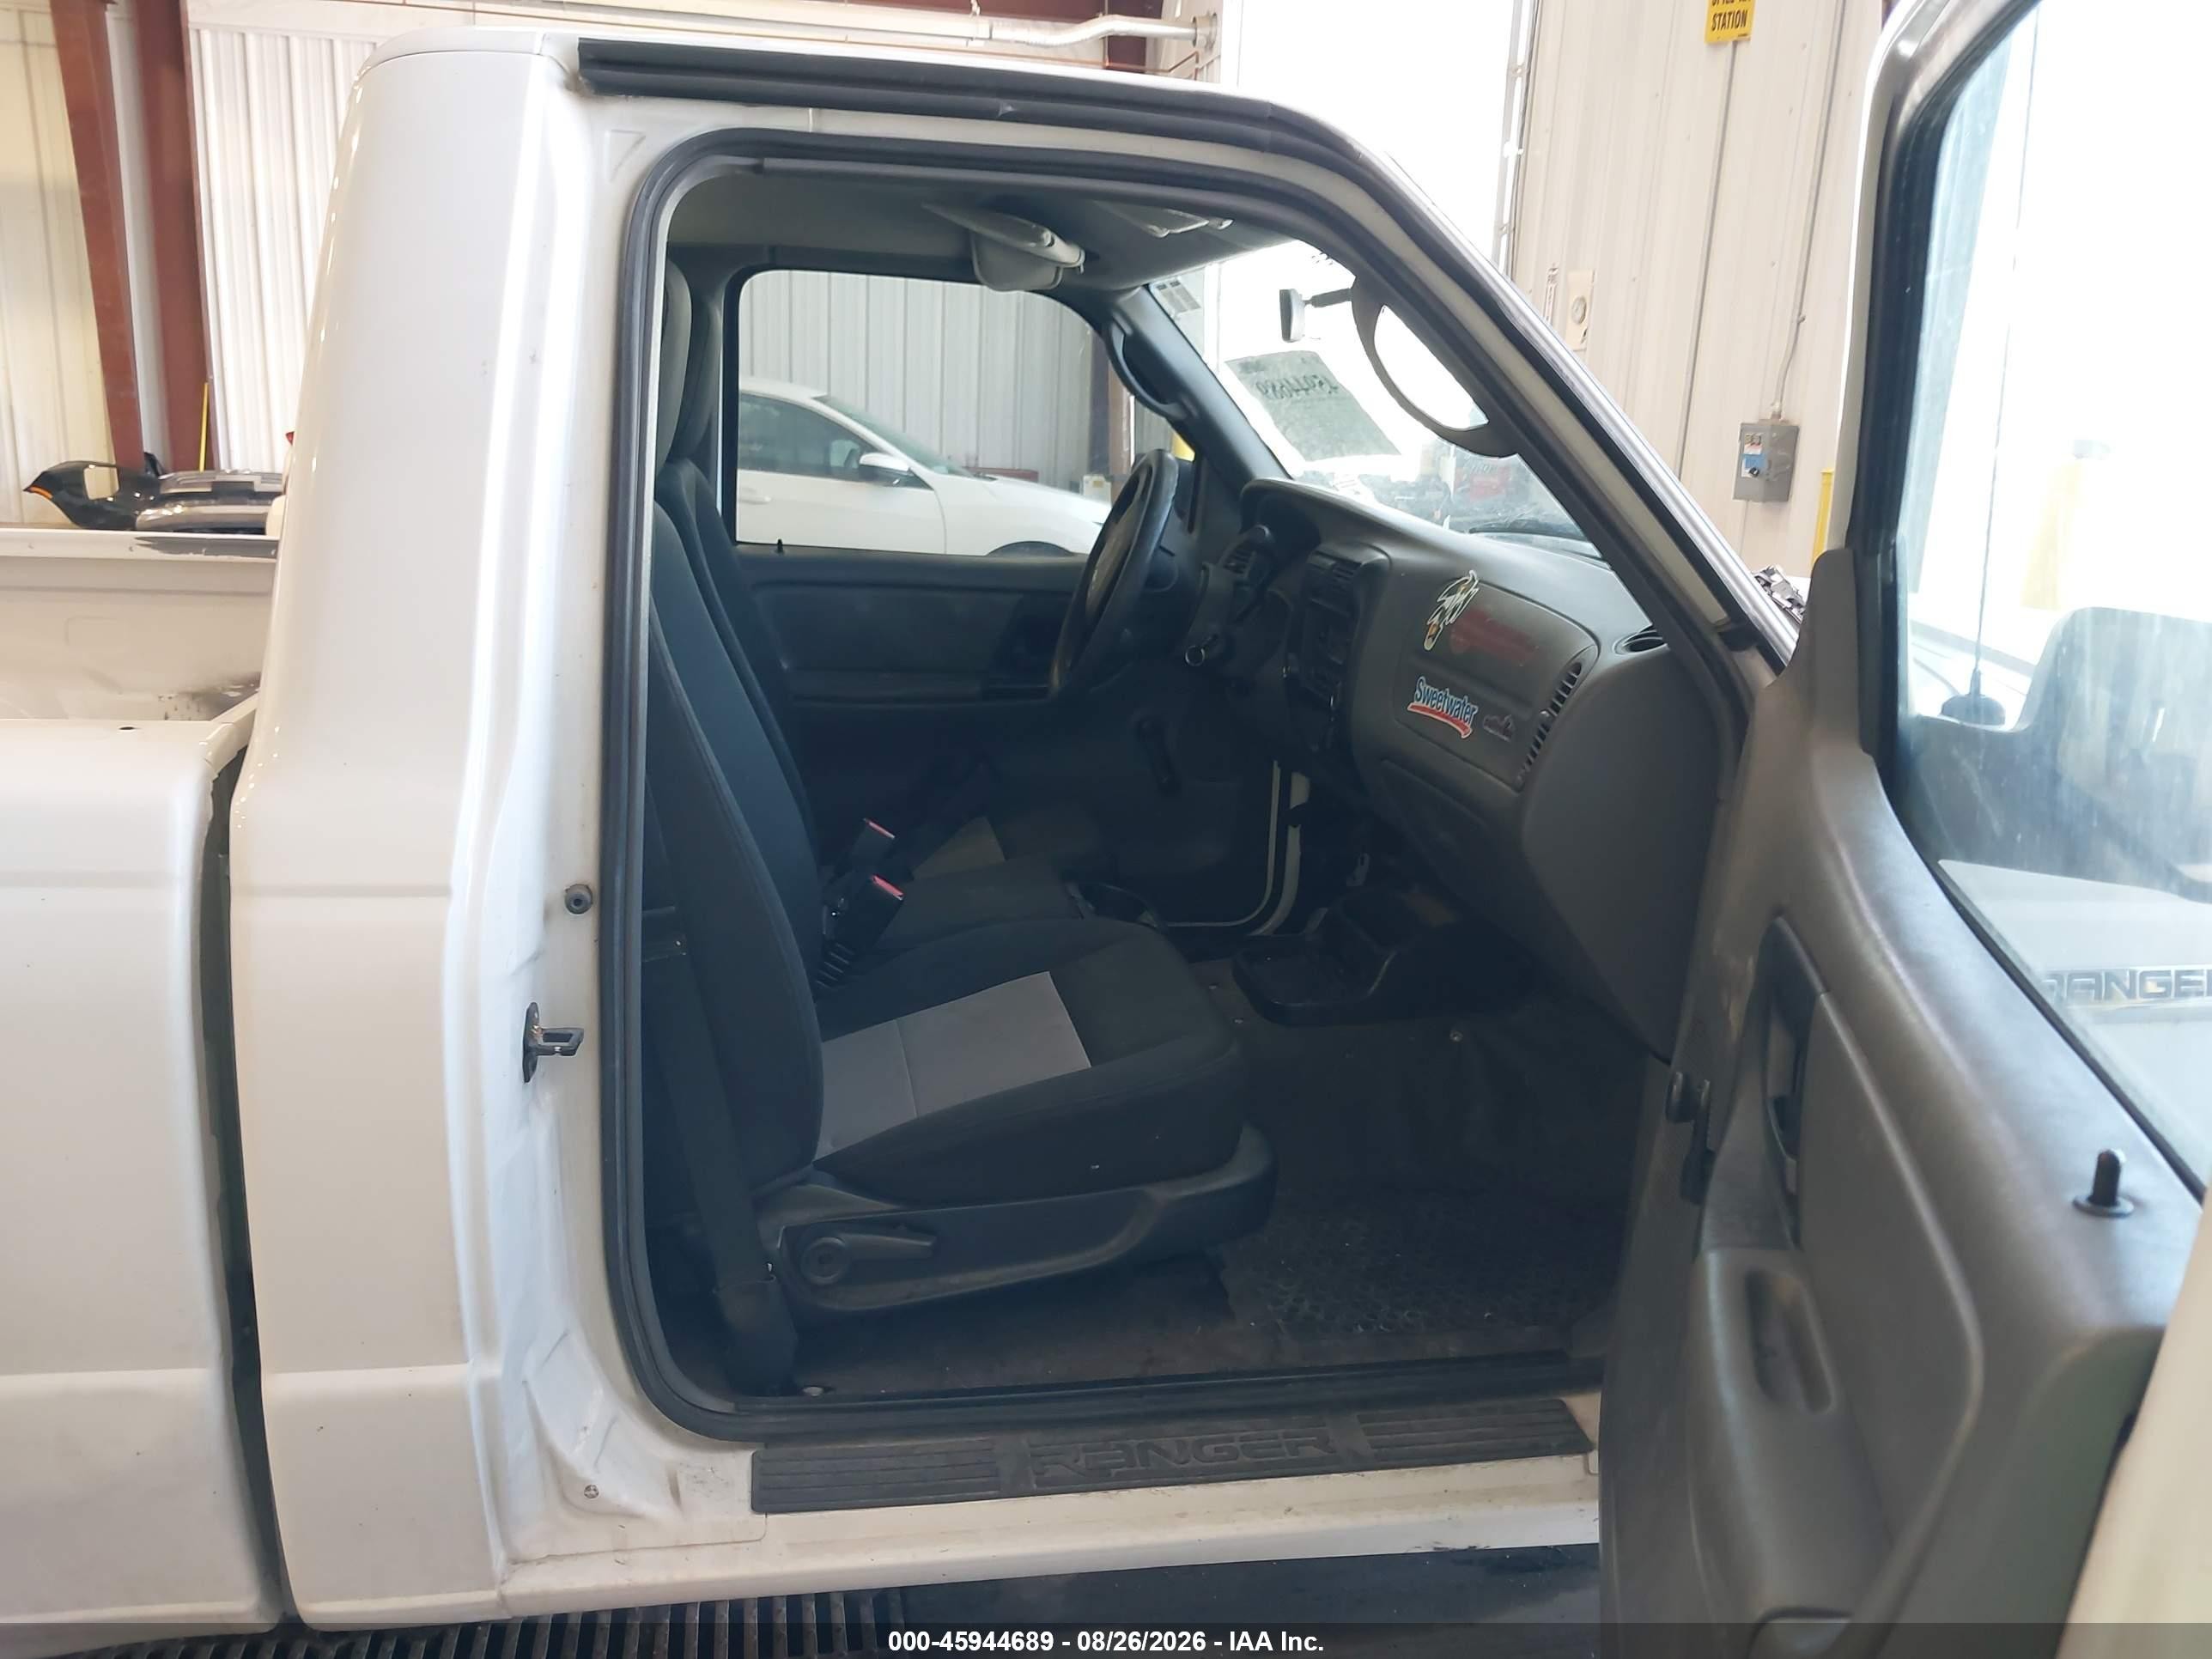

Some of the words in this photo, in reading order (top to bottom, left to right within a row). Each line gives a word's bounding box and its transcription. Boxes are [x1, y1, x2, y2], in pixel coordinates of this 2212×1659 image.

[1711, 9, 1747, 31] STATION
[1414, 677, 1478, 726] Sweetwater
[1030, 1428, 1337, 1477] RANGER
